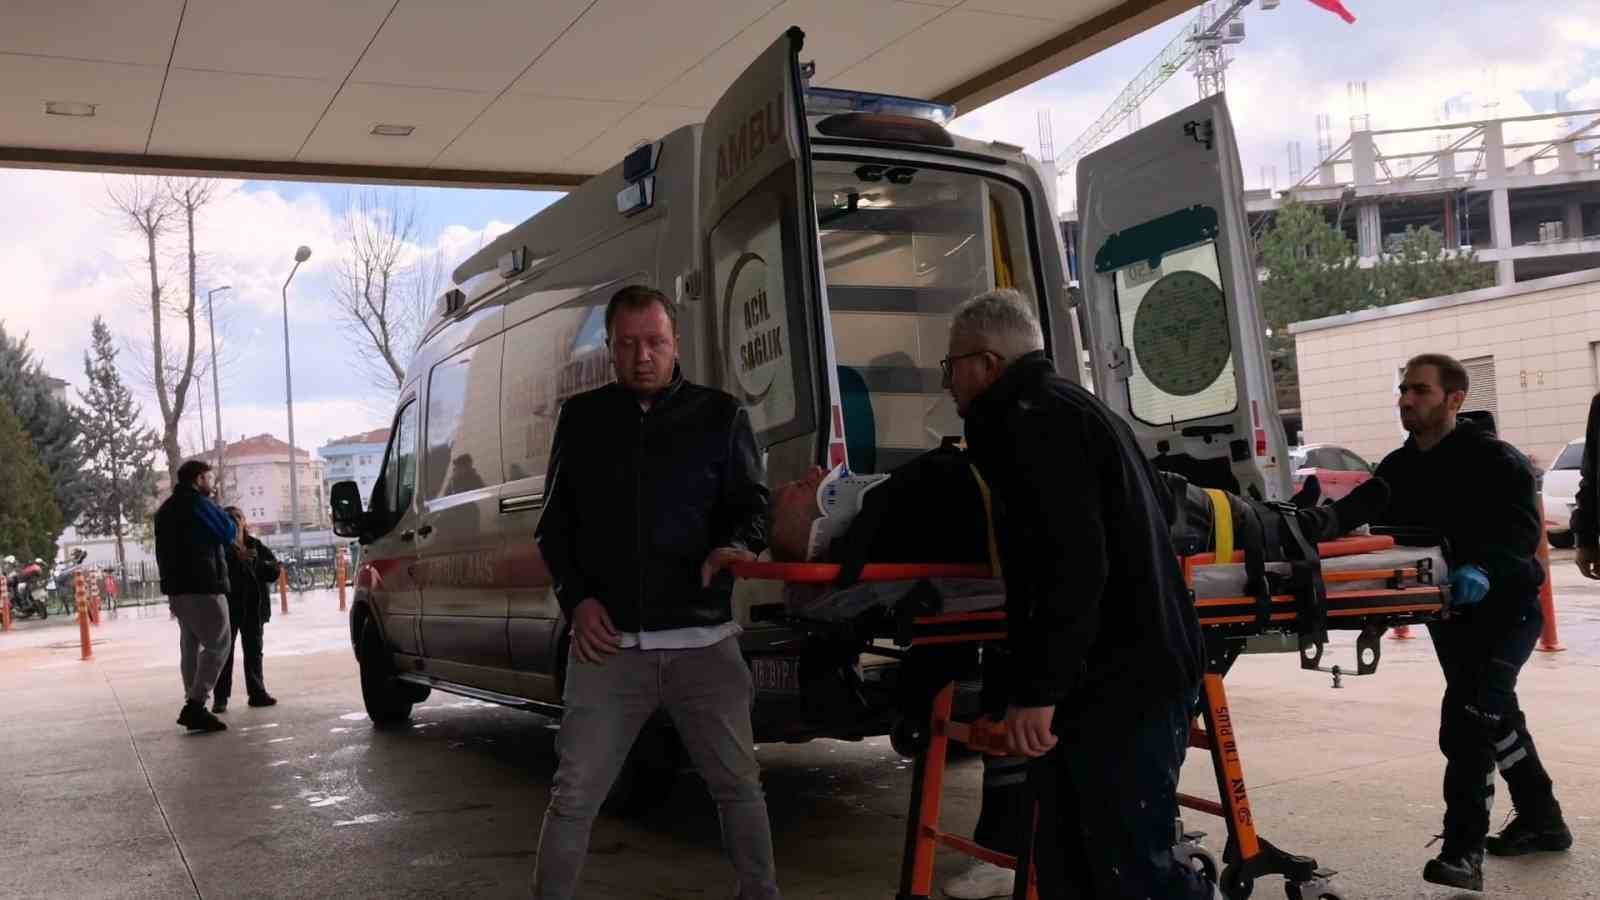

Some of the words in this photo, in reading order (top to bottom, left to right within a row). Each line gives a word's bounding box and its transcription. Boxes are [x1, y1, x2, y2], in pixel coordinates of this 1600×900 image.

[716, 91, 782, 188] AMBU
[740, 326, 782, 371] SAĞLIK
[1216, 706, 1234, 737] PLUS
